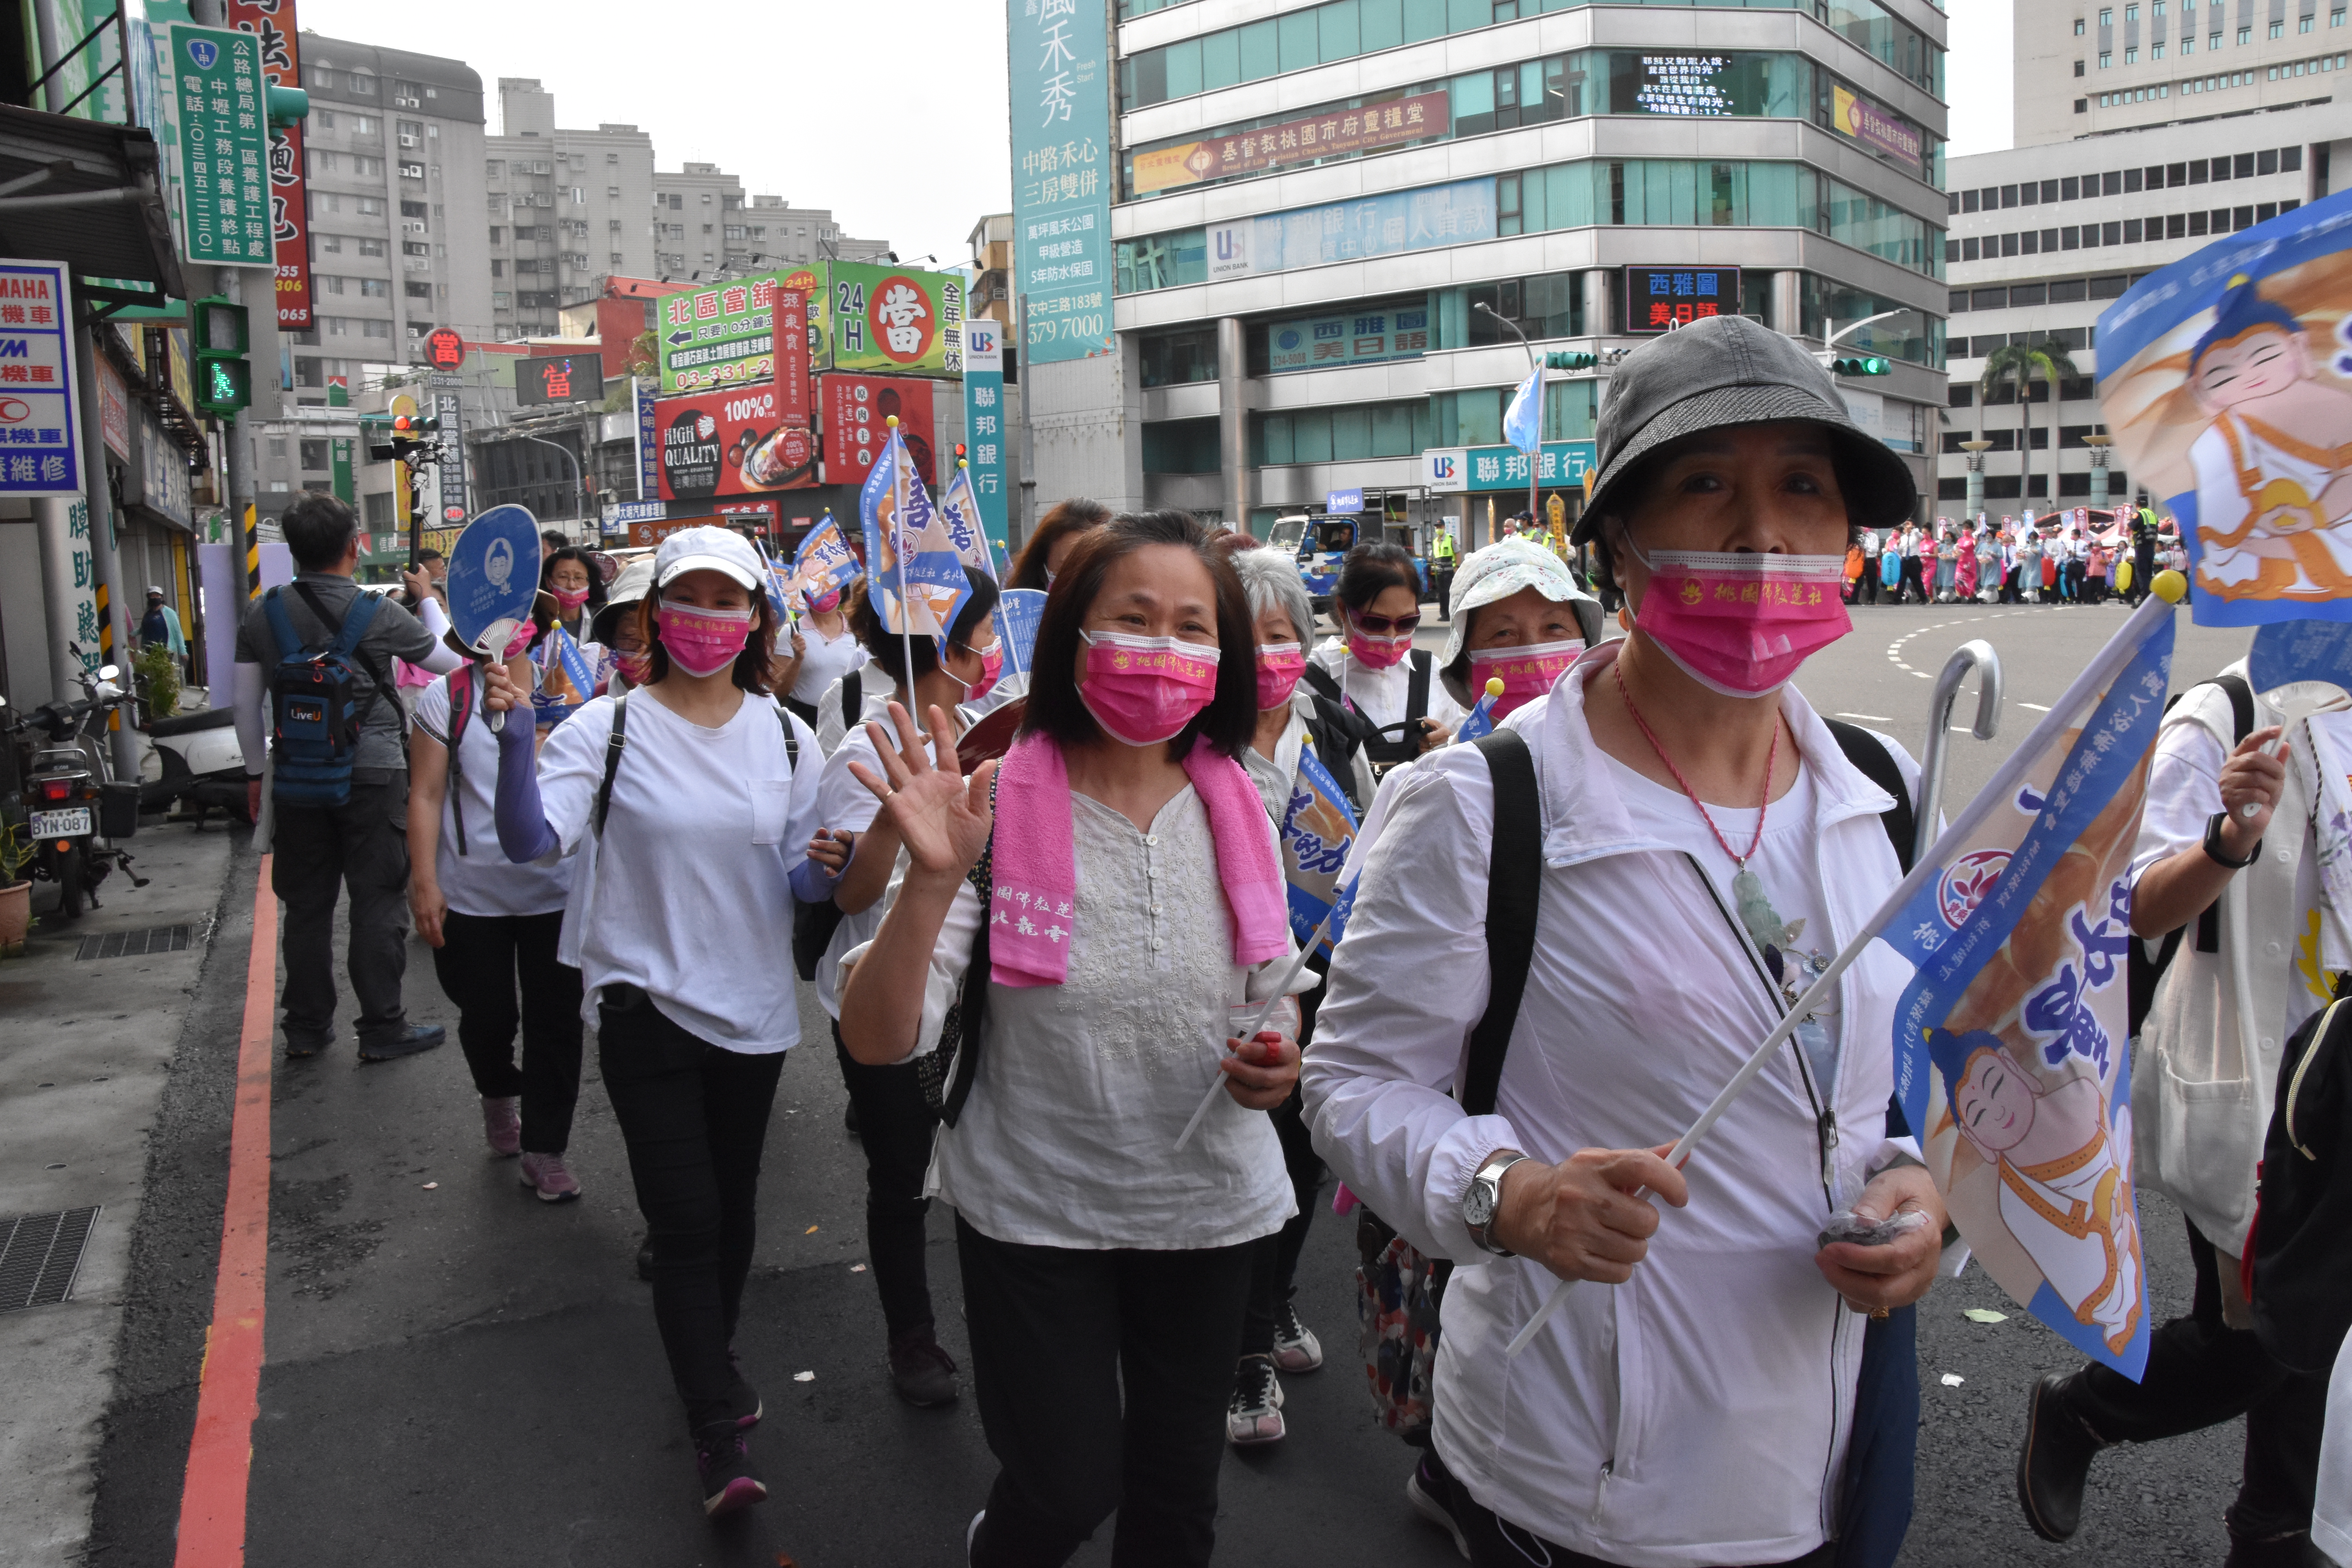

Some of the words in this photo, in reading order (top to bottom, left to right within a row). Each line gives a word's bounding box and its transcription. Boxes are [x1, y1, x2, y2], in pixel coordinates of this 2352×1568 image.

[199, 44, 204, 54] 1
[199, 54, 209, 65] 甲
[1077, 60, 1095, 71] Fresh
[1077, 72, 1094, 83] Start
[1222, 103, 1424, 162] 基督教桃園市府靈糧堂
[233, 40, 264, 257] 公路總局第一區養護工程處
[1023, 138, 1098, 176] 中路禾心
[1222, 163, 1240, 171] Bread
[1269, 152, 1299, 162] Christian
[1332, 140, 1359, 150] Taoyuan
[1363, 136, 1376, 145] City
[1380, 127, 1423, 140] Government
[211, 78, 240, 254] 中壢工務段養護終點
[1024, 169, 1098, 207] 三房雙併
[1028, 214, 1093, 240] 萬坪風禾公園
[1039, 239, 1083, 260] 甲級營造
[1031, 260, 1093, 284] 5年防水保固
[1214, 265, 1232, 273] UNION
[1232, 262, 1248, 271] BANK
[786, 276, 813, 287] 24H
[1648, 273, 1718, 296] 西雅圖
[838, 281, 865, 315] 24
[1, 305, 53, 324] 機車
[278, 309, 307, 321] 065
[878, 284, 926, 354] 當
[1314, 311, 1426, 340] 西雅圖
[1649, 302, 1719, 326] 美日語
[844, 319, 863, 352] H
[942, 281, 962, 372] 全年無休
[1028, 320, 1056, 345] 379
[1062, 314, 1103, 339] 7000
[432, 333, 459, 363] 當
[1314, 331, 1427, 360] 美日語
[1, 365, 54, 383] 機車
[432, 376, 462, 387] 331-2000
[664, 425, 695, 445] HIGH
[975, 387, 998, 494] 聯邦銀行
[665, 444, 720, 466] QUALITY
[1477, 452, 1586, 482] 聯邦銀行
[446, 508, 463, 519] 24H
[1714, 583, 1822, 608] 桃園佛教蓮社
[1136, 653, 1206, 678] 桃園佛教蓮社
[290, 708, 321, 720] LiveU
[33, 817, 89, 835] BYN-087
